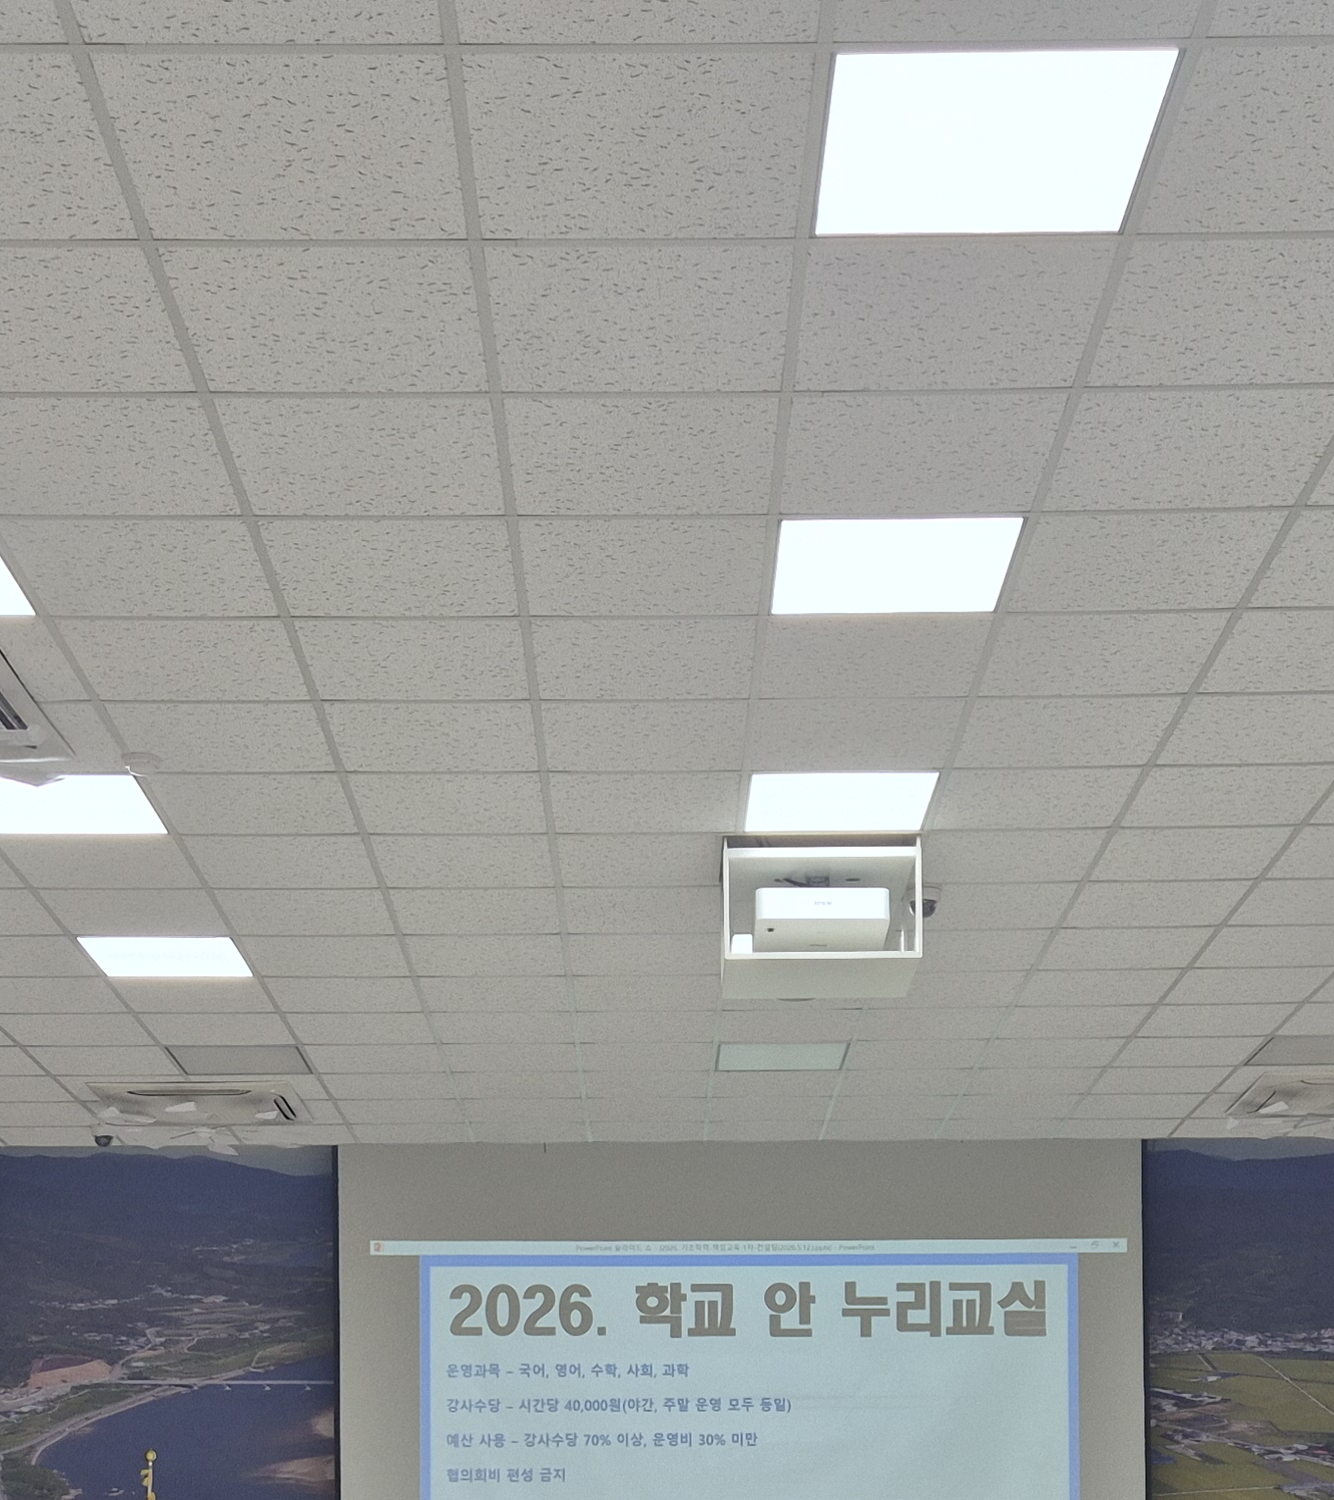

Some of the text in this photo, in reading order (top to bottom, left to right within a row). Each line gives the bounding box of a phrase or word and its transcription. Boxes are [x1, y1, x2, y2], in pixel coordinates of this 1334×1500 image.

[448, 1280, 1047, 1339] 2026. 학교 안 누리교실
[447, 1363, 501, 1379] 운영과목
[518, 1362, 549, 1379] 국어,
[554, 1363, 586, 1379] 영어,
[590, 1363, 621, 1379] 수학,
[626, 1363, 657, 1379] 사회,
[662, 1363, 690, 1378] 과학
[447, 1398, 501, 1414] 강사수당
[518, 1397, 560, 1414] 시간당
[564, 1397, 658, 1414] 40,000원(야간,
[662, 1397, 690, 1413] 주말
[695, 1397, 722, 1413] 운영
[727, 1396, 755, 1413] 모두
[759, 1396, 792, 1414] 동일)
[446, 1433, 474, 1448] 예산
[479, 1432, 506, 1449] 사용
[524, 1432, 578, 1448] 강사수당
[583, 1433, 612, 1447] 70%
[616, 1432, 647, 1448] 이상,
[652, 1432, 693, 1448] 운영비
[698, 1433, 727, 1447] 30%
[731, 1431, 759, 1447] 미만
[447, 1467, 566, 1483] 협의회비 편성 금지
